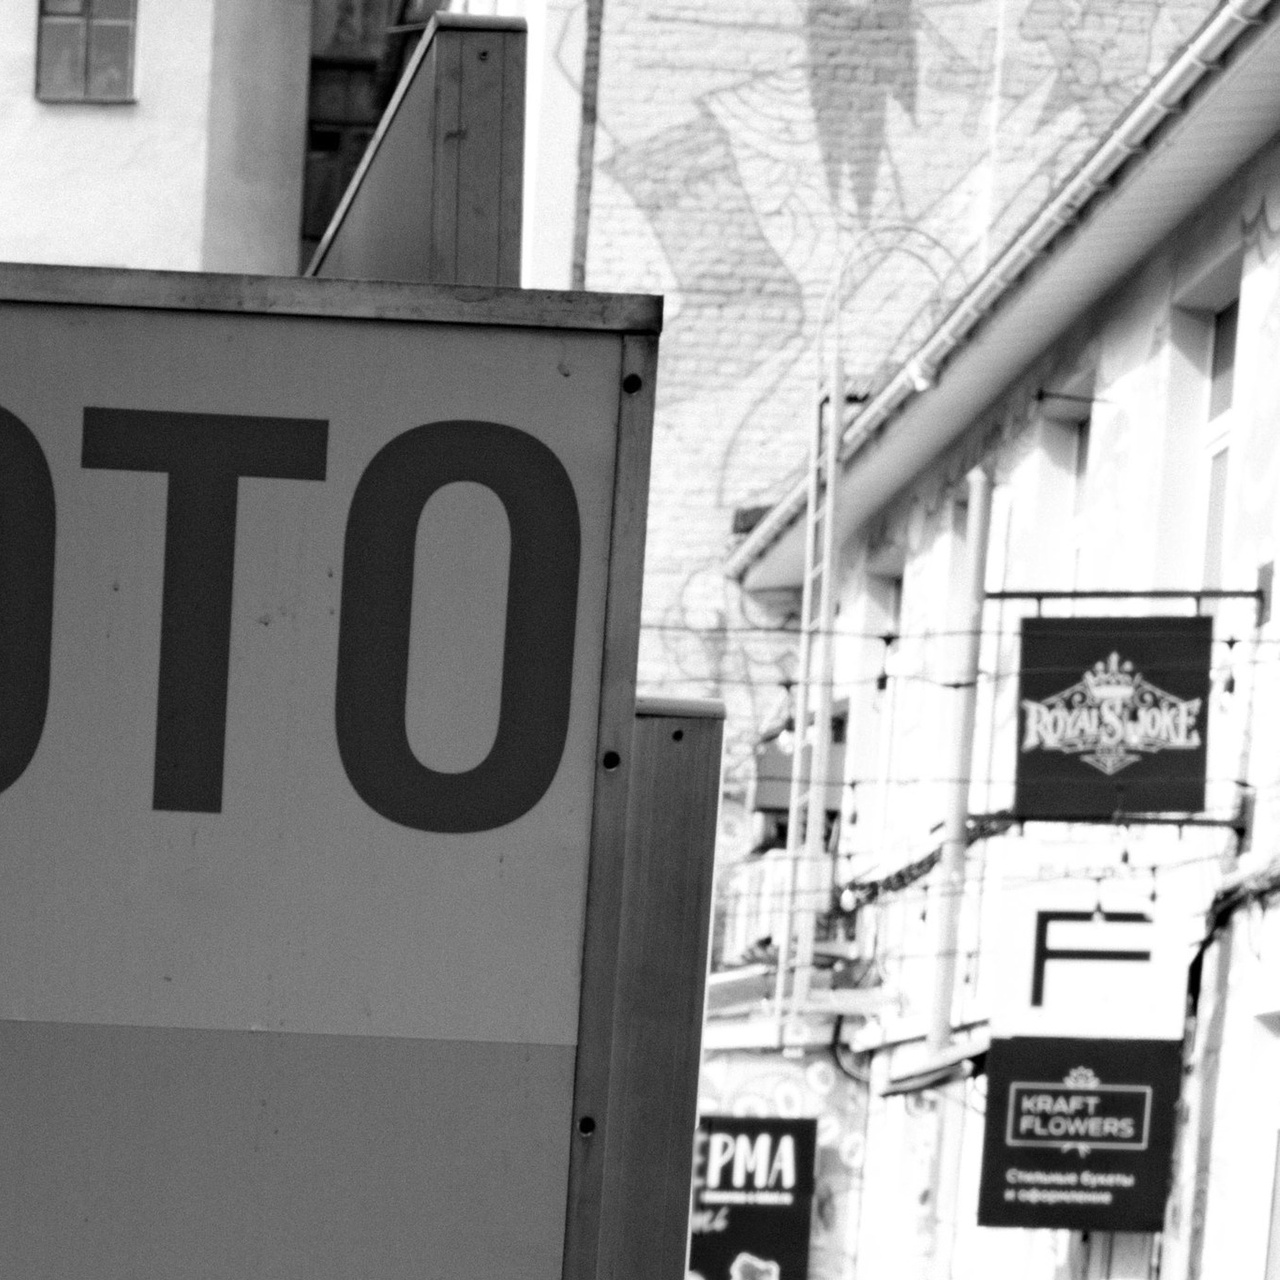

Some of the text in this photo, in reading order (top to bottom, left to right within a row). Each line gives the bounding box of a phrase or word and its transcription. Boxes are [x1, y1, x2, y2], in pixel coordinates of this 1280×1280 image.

[1031, 911, 1153, 1007] F
[1021, 1094, 1100, 1115] KRAFT
[1020, 1115, 1135, 1138] FLOWERS
